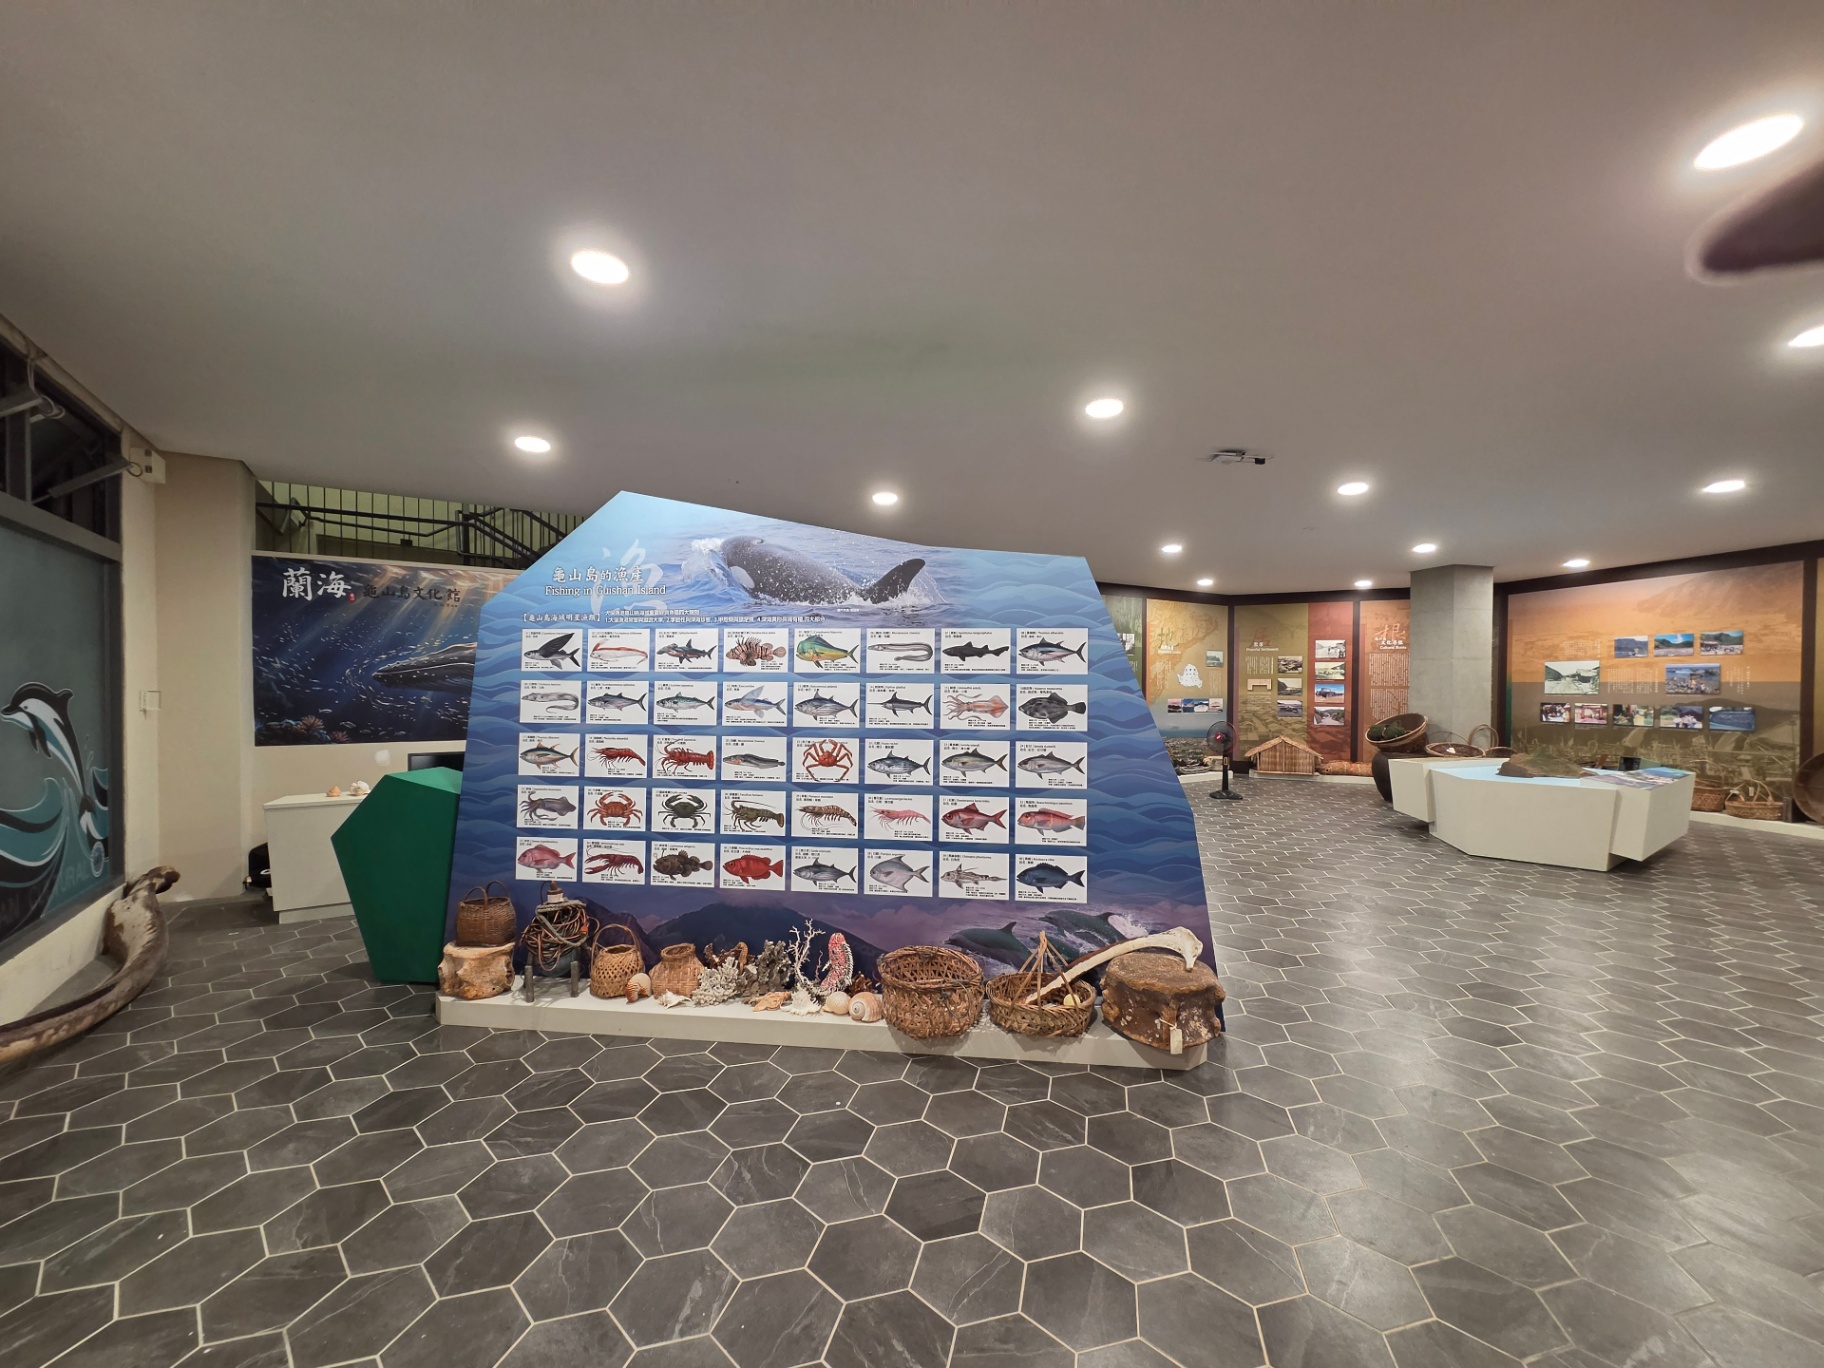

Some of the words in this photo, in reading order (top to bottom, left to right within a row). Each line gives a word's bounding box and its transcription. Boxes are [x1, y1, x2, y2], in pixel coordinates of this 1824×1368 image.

[553, 565, 644, 583] 龜山島的漁產
[282, 567, 352, 601] 蘭海
[363, 583, 462, 603] 龜山島文化館
[545, 585, 580, 597] Fishing
[583, 585, 592, 595] in
[597, 585, 633, 595] Guishan
[637, 585, 666, 595] Island
